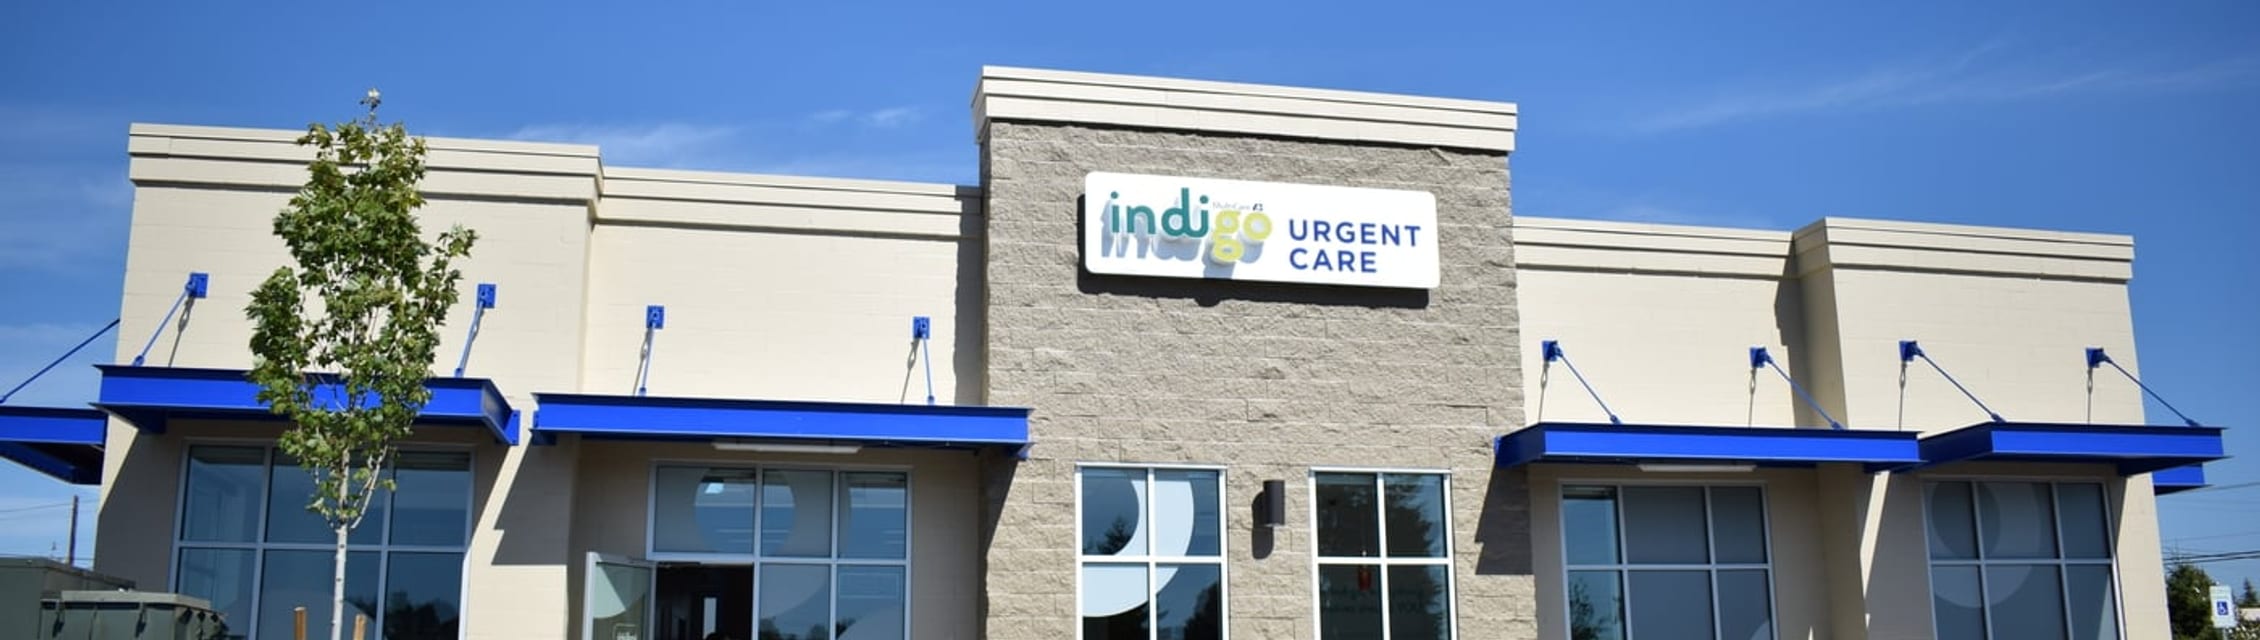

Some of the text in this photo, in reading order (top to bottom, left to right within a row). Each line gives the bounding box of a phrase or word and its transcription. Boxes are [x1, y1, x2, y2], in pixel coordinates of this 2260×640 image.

[1110, 187, 1273, 262] indigo
[1289, 219, 1421, 247] URGENT
[1289, 247, 1377, 273] CARE
